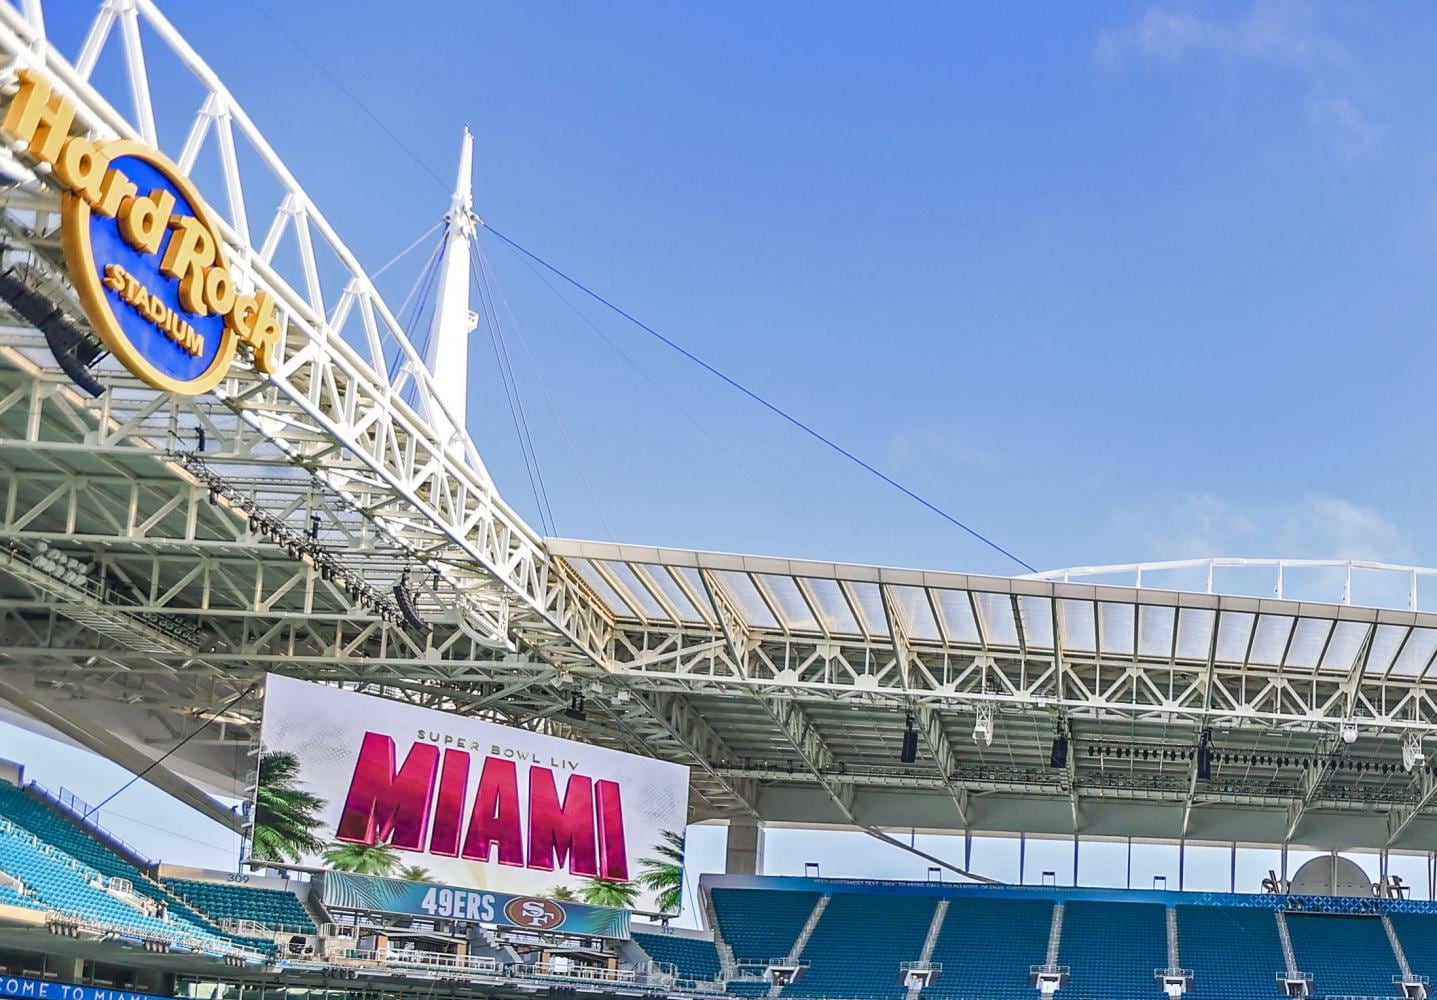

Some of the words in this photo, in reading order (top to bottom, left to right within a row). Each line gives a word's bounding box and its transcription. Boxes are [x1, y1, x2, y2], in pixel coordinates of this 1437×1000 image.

[2, 69, 177, 255] Hard
[160, 214, 282, 376] Rock
[103, 262, 205, 358] STADIUM
[416, 729, 481, 751] SUPER
[491, 745, 541, 764] BOWL
[550, 758, 580, 771] LIV
[335, 731, 631, 882] MIAMI
[227, 873, 250, 884] 309
[421, 887, 496, 921] 49ERS
[522, 901, 555, 929] SF
[62, 985, 84, 1000] TO
